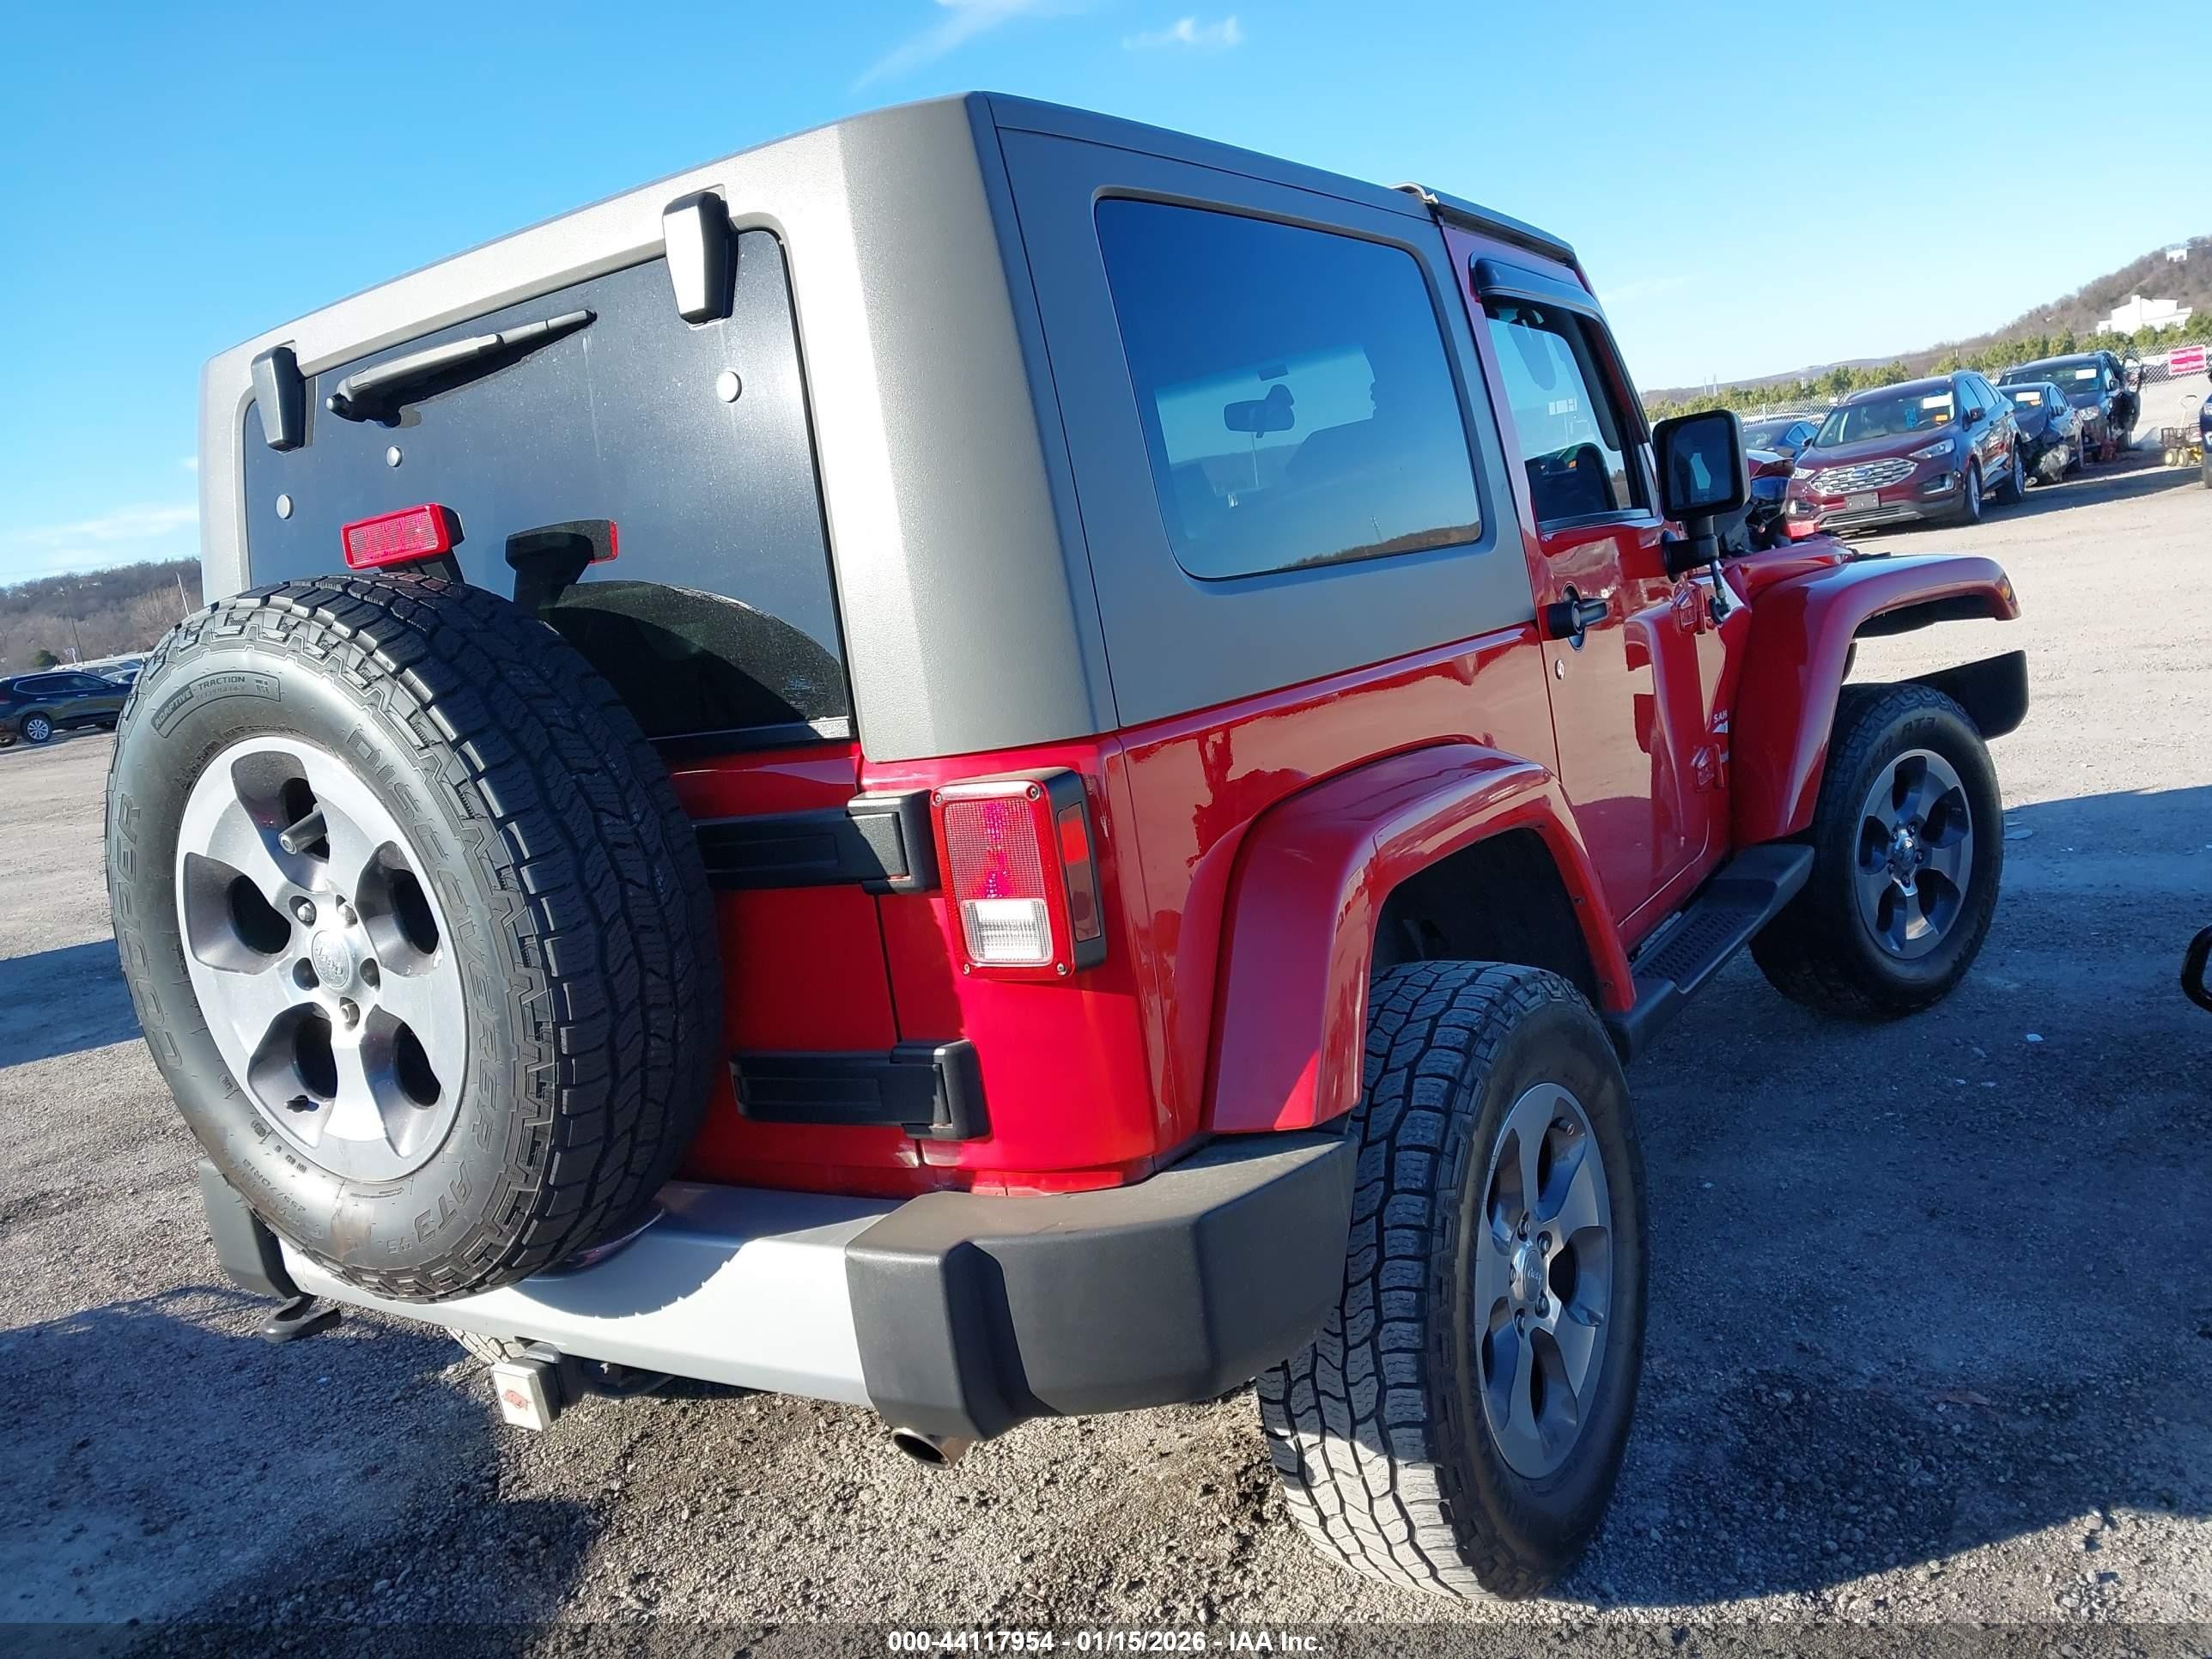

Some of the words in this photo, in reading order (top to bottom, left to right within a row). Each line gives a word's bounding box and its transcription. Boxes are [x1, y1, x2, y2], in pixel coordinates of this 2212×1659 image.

[155, 687, 193, 728] ADAPTIVE
[115, 792, 184, 1069] COOPER
[345, 732, 500, 1154] DISCOVERER
